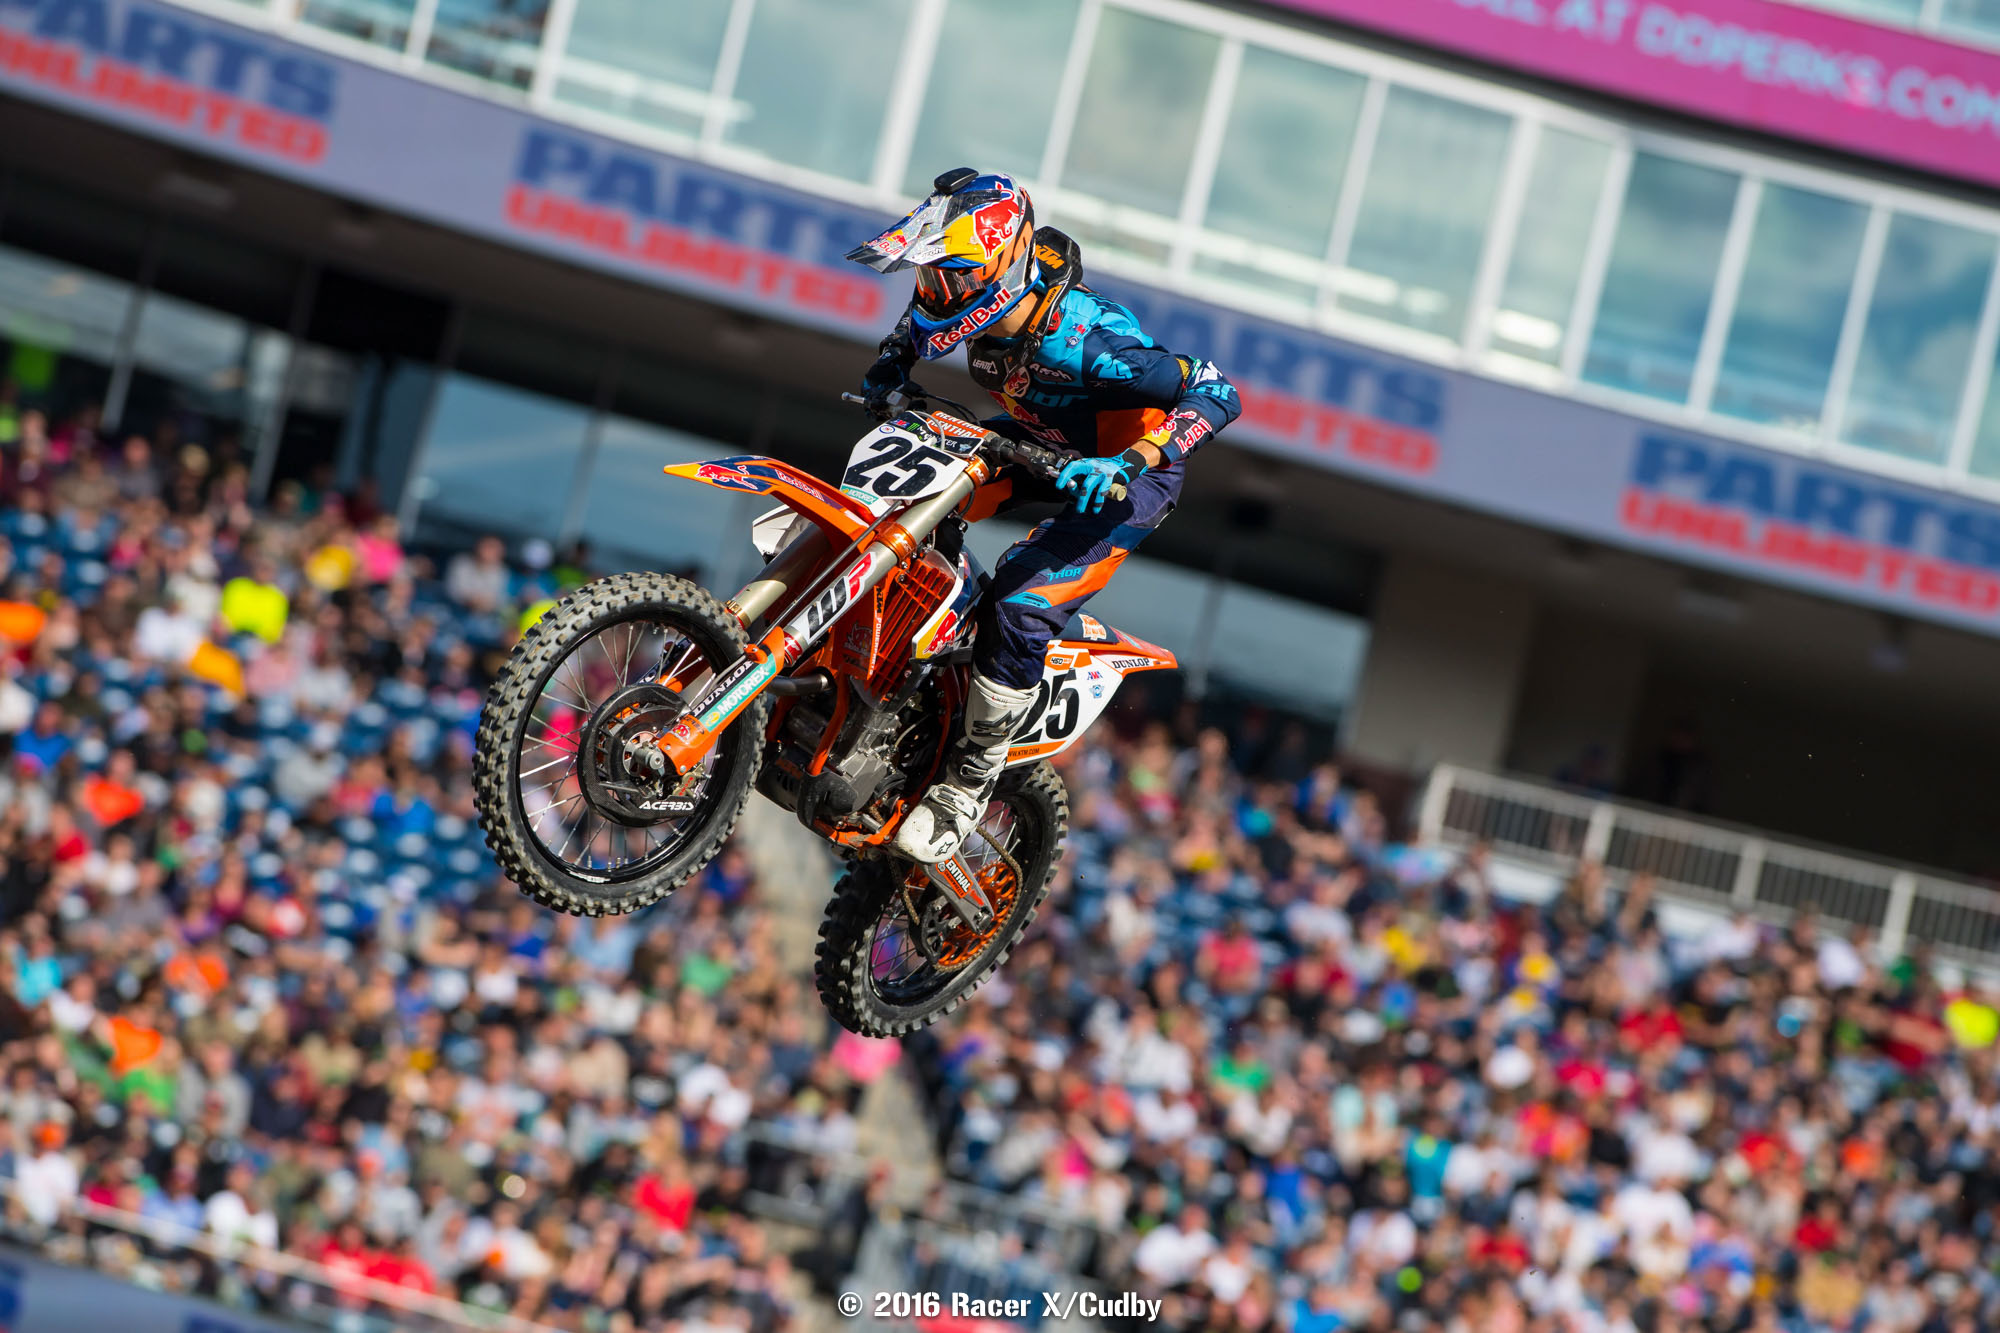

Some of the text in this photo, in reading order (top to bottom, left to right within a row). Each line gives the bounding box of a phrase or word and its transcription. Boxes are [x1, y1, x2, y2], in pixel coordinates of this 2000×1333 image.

[0, 0, 335, 122] ARTS
[0, 25, 327, 167] NLIMITED
[505, 182, 888, 326] UNLIMITED
[1034, 244, 1065, 270] KTM
[928, 287, 1012, 352] Red Bull
[1228, 378, 1440, 477] MITED
[843, 436, 956, 498] 25
[1048, 567, 1082, 582] THOR
[716, 666, 769, 715] MOTOREX
[1086, 671, 1103, 680] AMA
[1112, 658, 1150, 669] DUNLOP
[1011, 668, 1080, 744] 25
[639, 801, 694, 811] ACERBIS
[945, 860, 971, 893] ENTHAL
